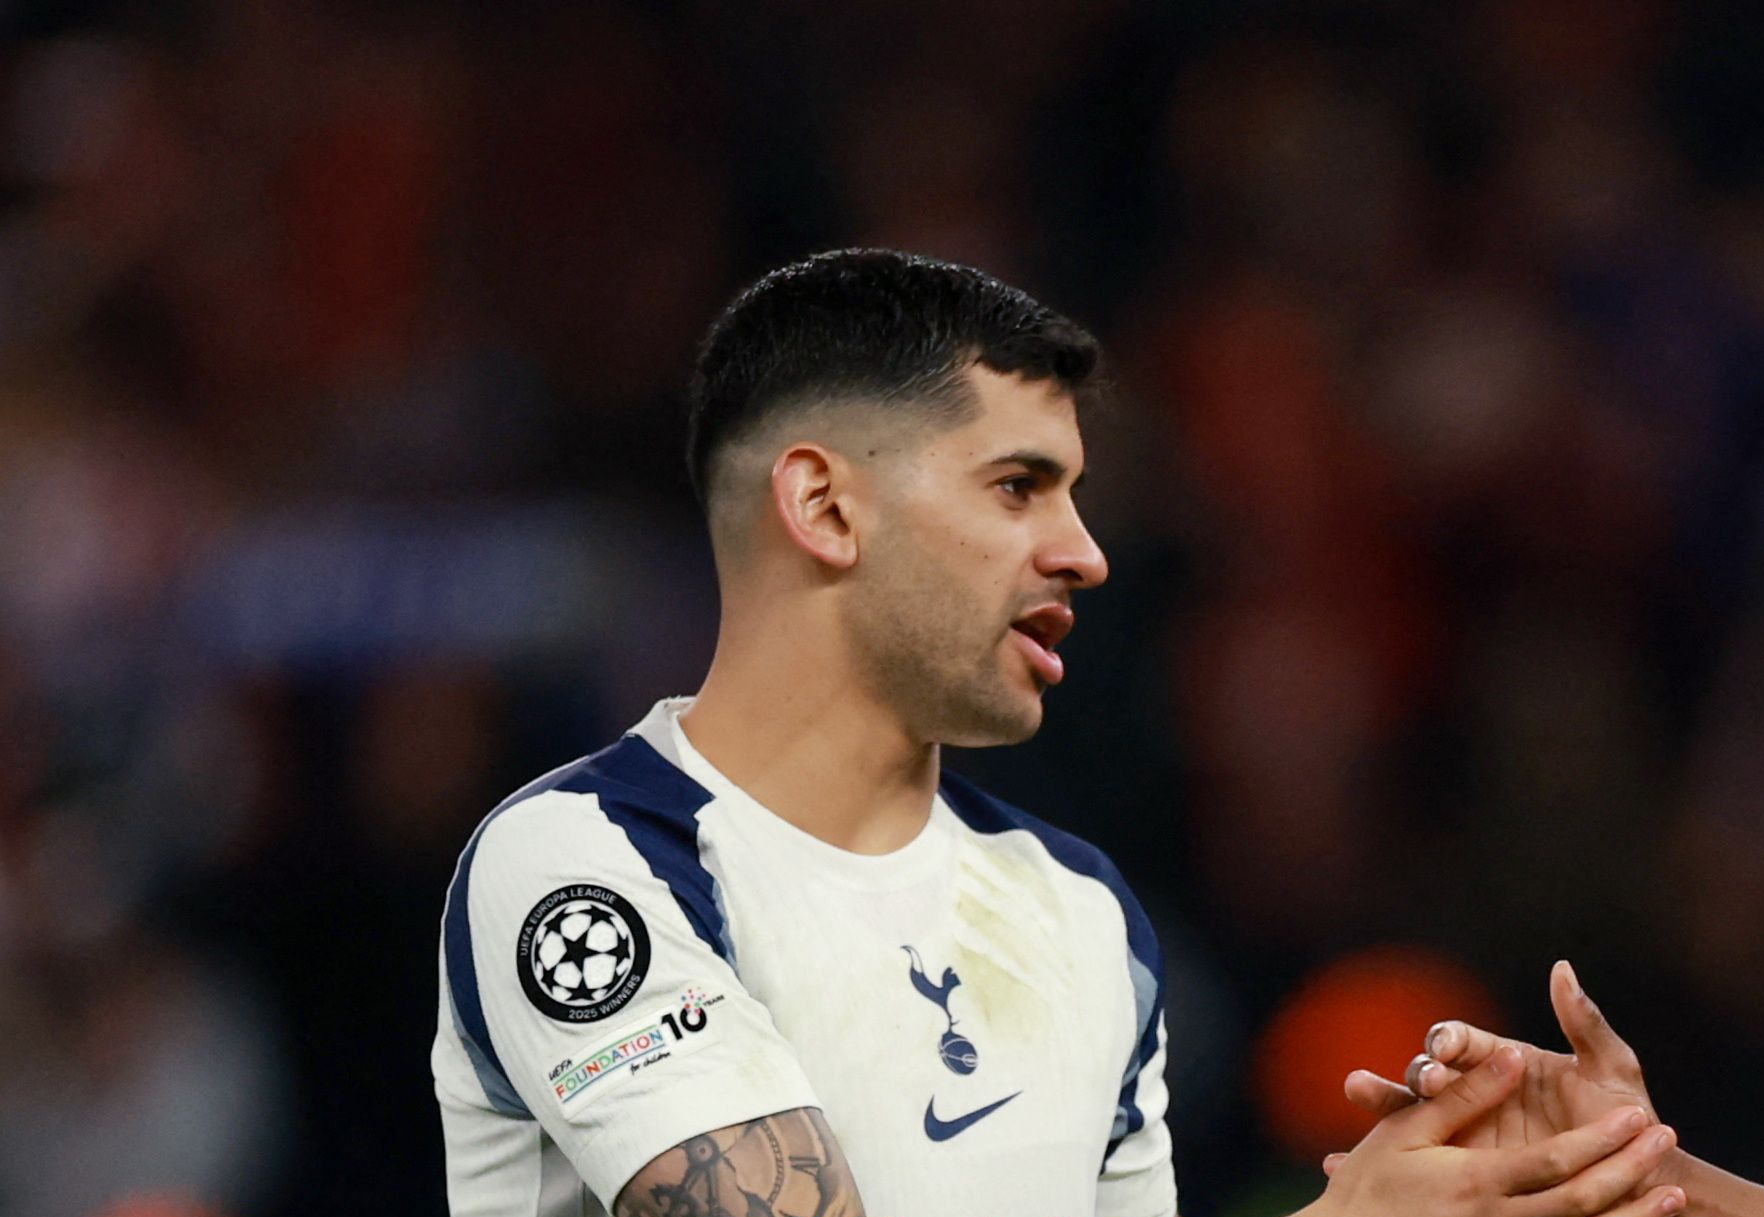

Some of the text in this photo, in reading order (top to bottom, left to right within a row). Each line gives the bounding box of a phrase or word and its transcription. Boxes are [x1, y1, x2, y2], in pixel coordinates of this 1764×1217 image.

[520, 887, 617, 956] UEFA EUROPA LEAGUE
[568, 974, 641, 1020] 2025 WINNERS
[661, 1006, 708, 1041] 10
[549, 1058, 573, 1081] UEFA
[555, 1029, 664, 1099] FOUNDATION
[630, 1051, 672, 1076] for children
